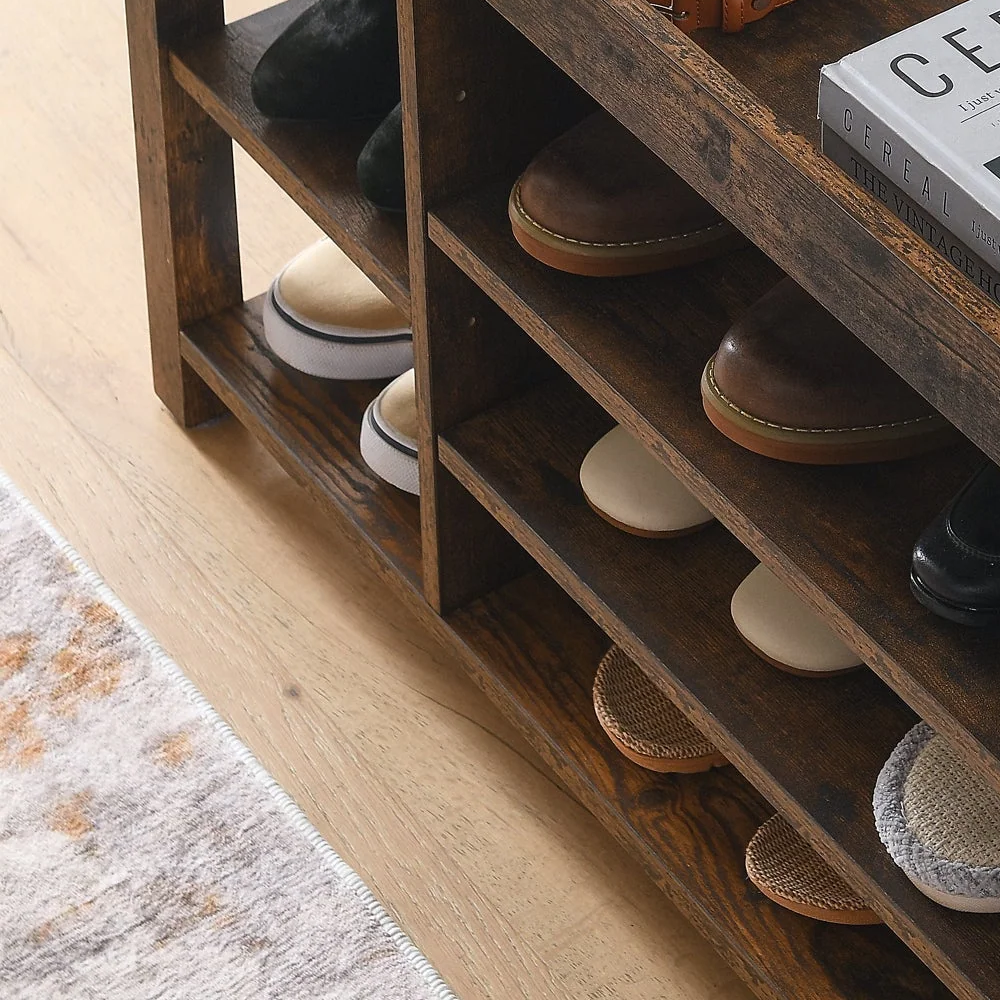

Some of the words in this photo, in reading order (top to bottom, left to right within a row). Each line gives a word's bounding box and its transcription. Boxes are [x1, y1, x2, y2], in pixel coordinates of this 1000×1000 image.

[958, 104, 967, 112] I
[966, 92, 995, 111] just
[844, 108, 950, 218] CEREAL
[851, 157, 888, 203] THE
[893, 193, 975, 279] VINTAGE
[971, 220, 976, 233] I
[976, 225, 996, 250] just
